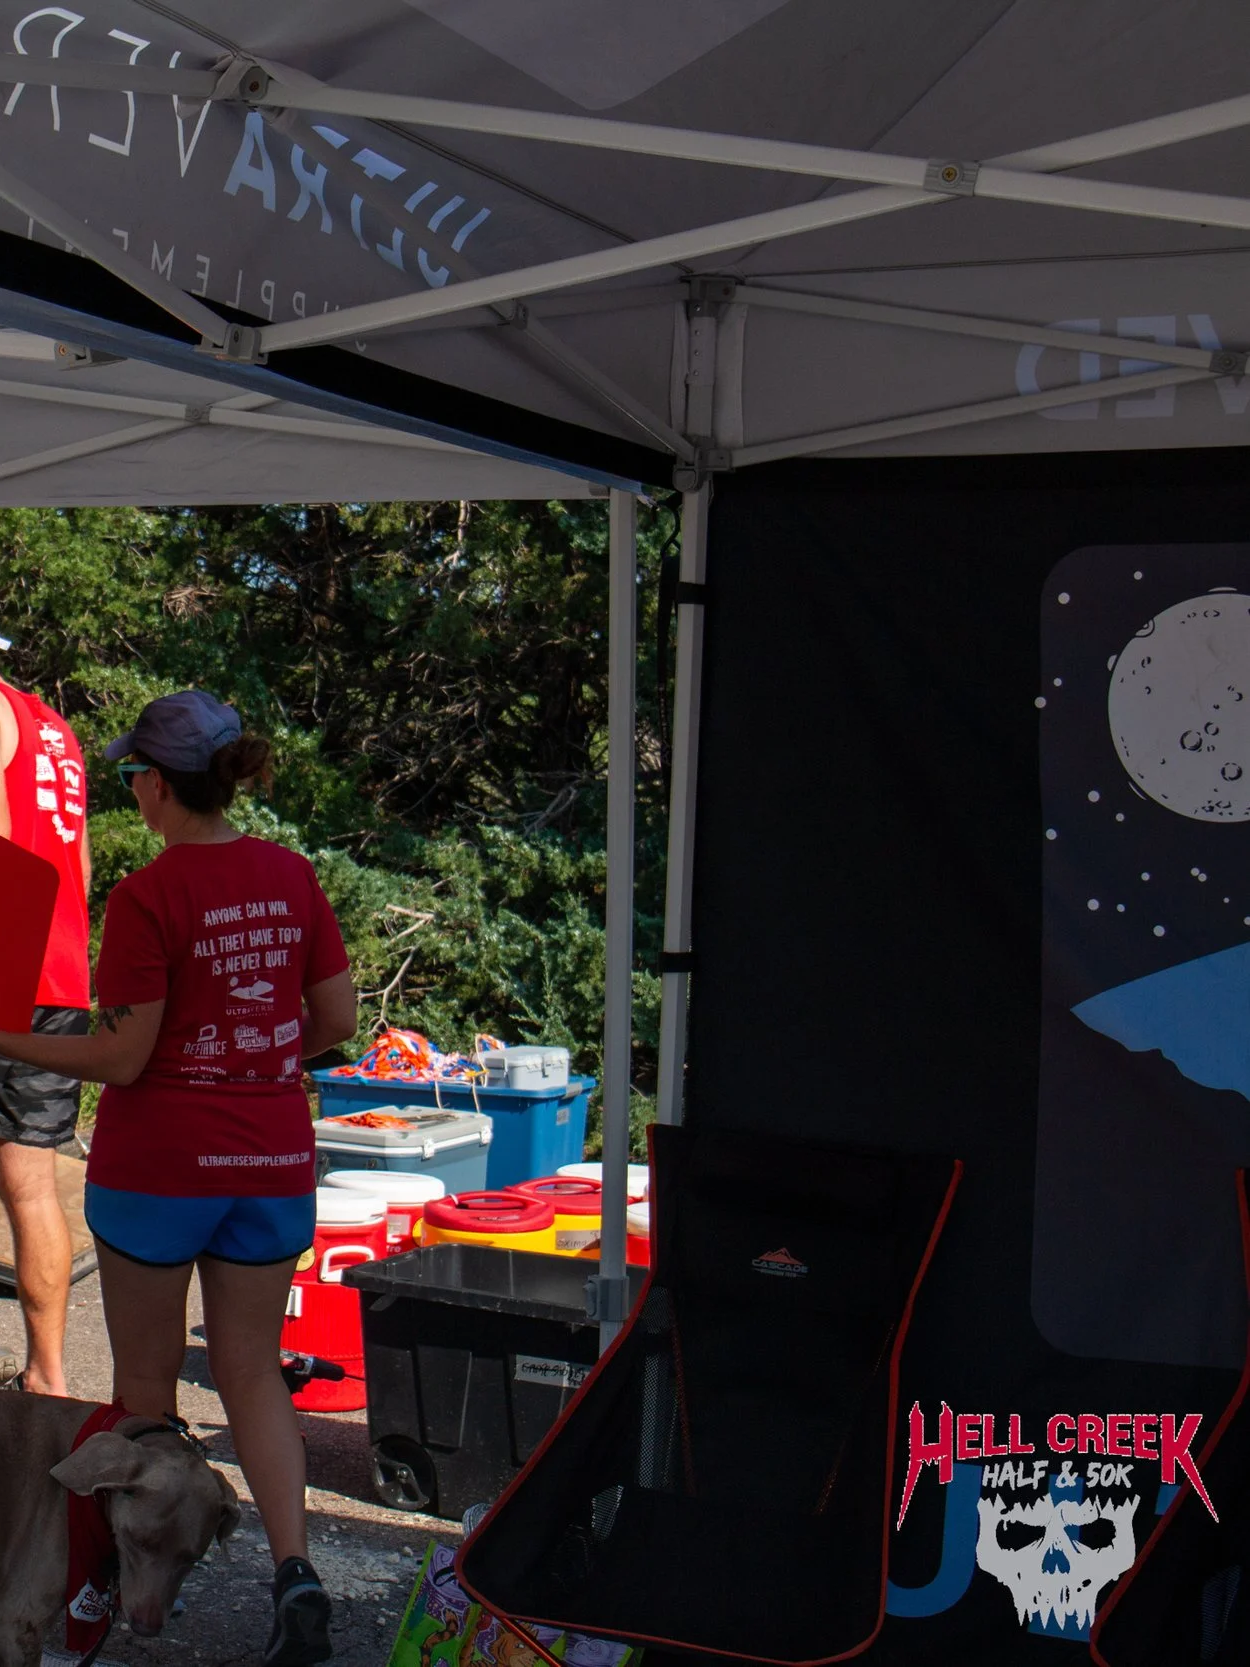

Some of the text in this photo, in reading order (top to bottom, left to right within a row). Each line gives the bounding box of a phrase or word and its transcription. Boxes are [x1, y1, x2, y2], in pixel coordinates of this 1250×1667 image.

[204, 905, 243, 927] ANYONE
[246, 902, 266, 918] CAN
[193, 939, 217, 958] ALL
[218, 932, 245, 953] THEY
[249, 928, 274, 947] HAVE
[278, 927, 291, 944] TO
[212, 960, 223, 976] IS
[225, 952, 260, 973] NEVER
[183, 1041, 227, 1055] DEFIANCE
